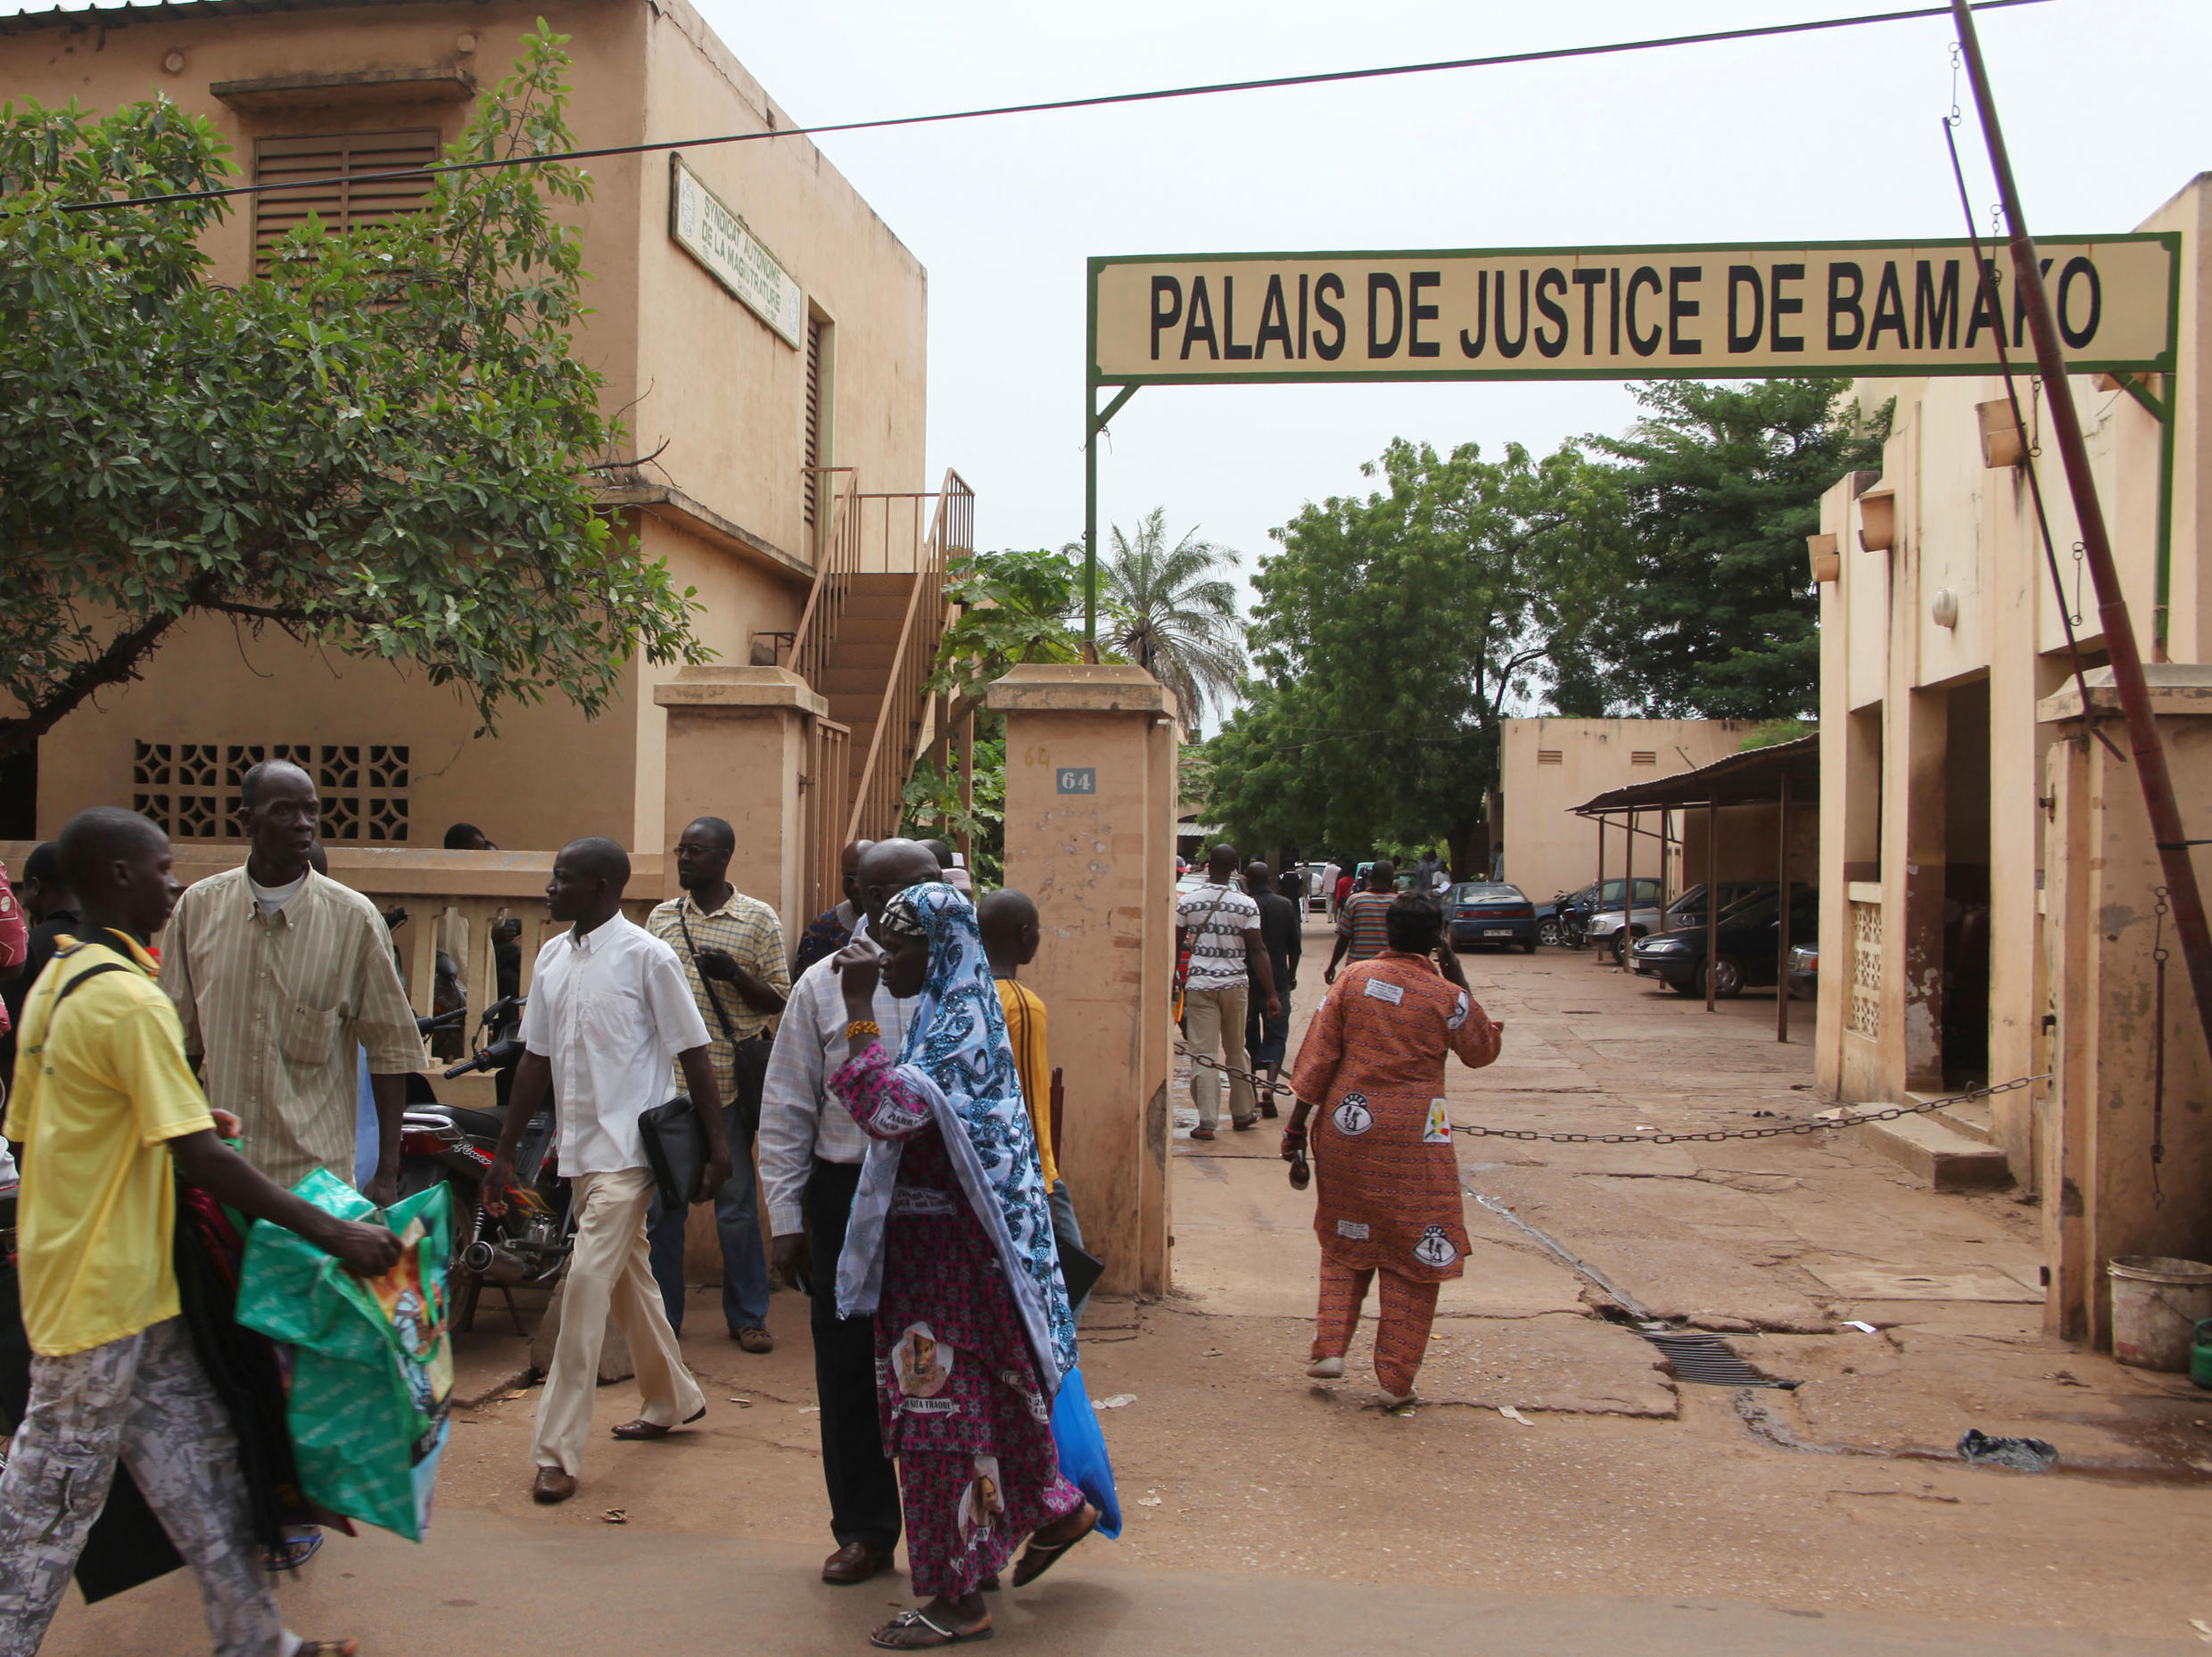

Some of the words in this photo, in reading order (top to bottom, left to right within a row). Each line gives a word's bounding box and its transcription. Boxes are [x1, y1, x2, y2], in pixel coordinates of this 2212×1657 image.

[701, 219, 713, 248] DE
[714, 236, 725, 261] LA
[727, 245, 781, 313] MAGISTRATURE
[703, 195, 741, 245] SYNDICAT
[743, 237, 781, 289] AUTONOME
[1150, 271, 1346, 361] PALAIS
[1367, 270, 1441, 359] DE
[1460, 266, 1702, 359] JUSTICE
[1727, 263, 1805, 354] DE
[1061, 771, 1091, 790] 64
[452, 1141, 493, 1165] Power
